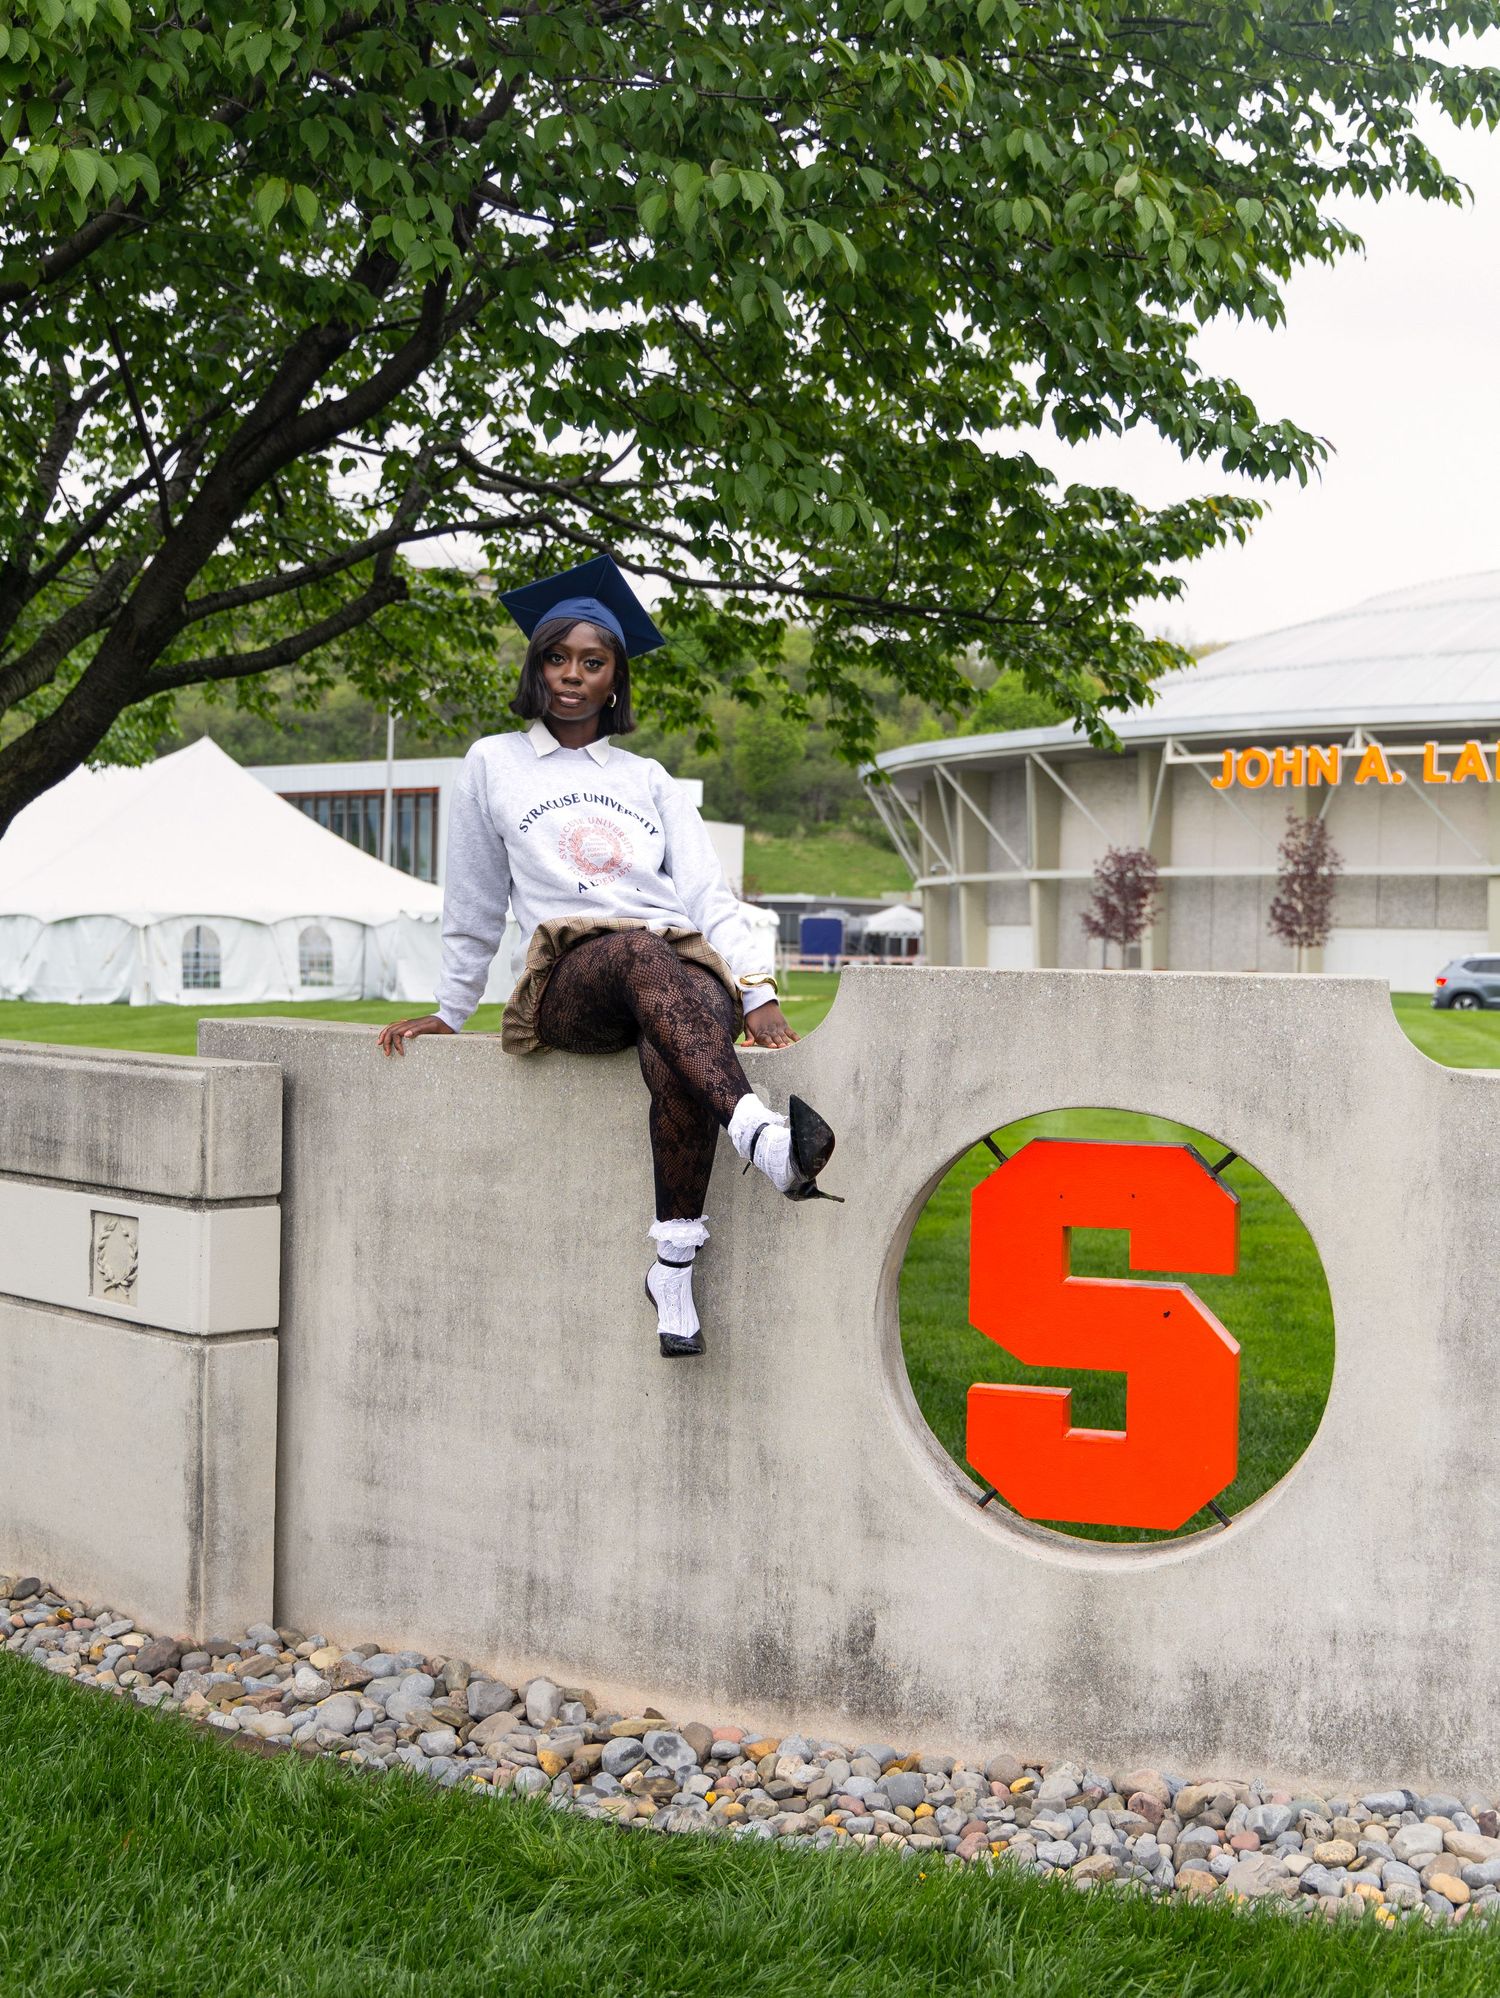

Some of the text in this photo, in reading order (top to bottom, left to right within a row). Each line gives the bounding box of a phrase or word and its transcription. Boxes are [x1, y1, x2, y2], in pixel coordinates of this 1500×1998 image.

[1210, 740, 1500, 789] JOHN A. LA
[519, 793, 659, 836] SYRACUSE UNIVERSITY
[587, 816, 634, 856] UNIVERSITY
[617, 862, 633, 878] 1870
[966, 1137, 1241, 1531] S
